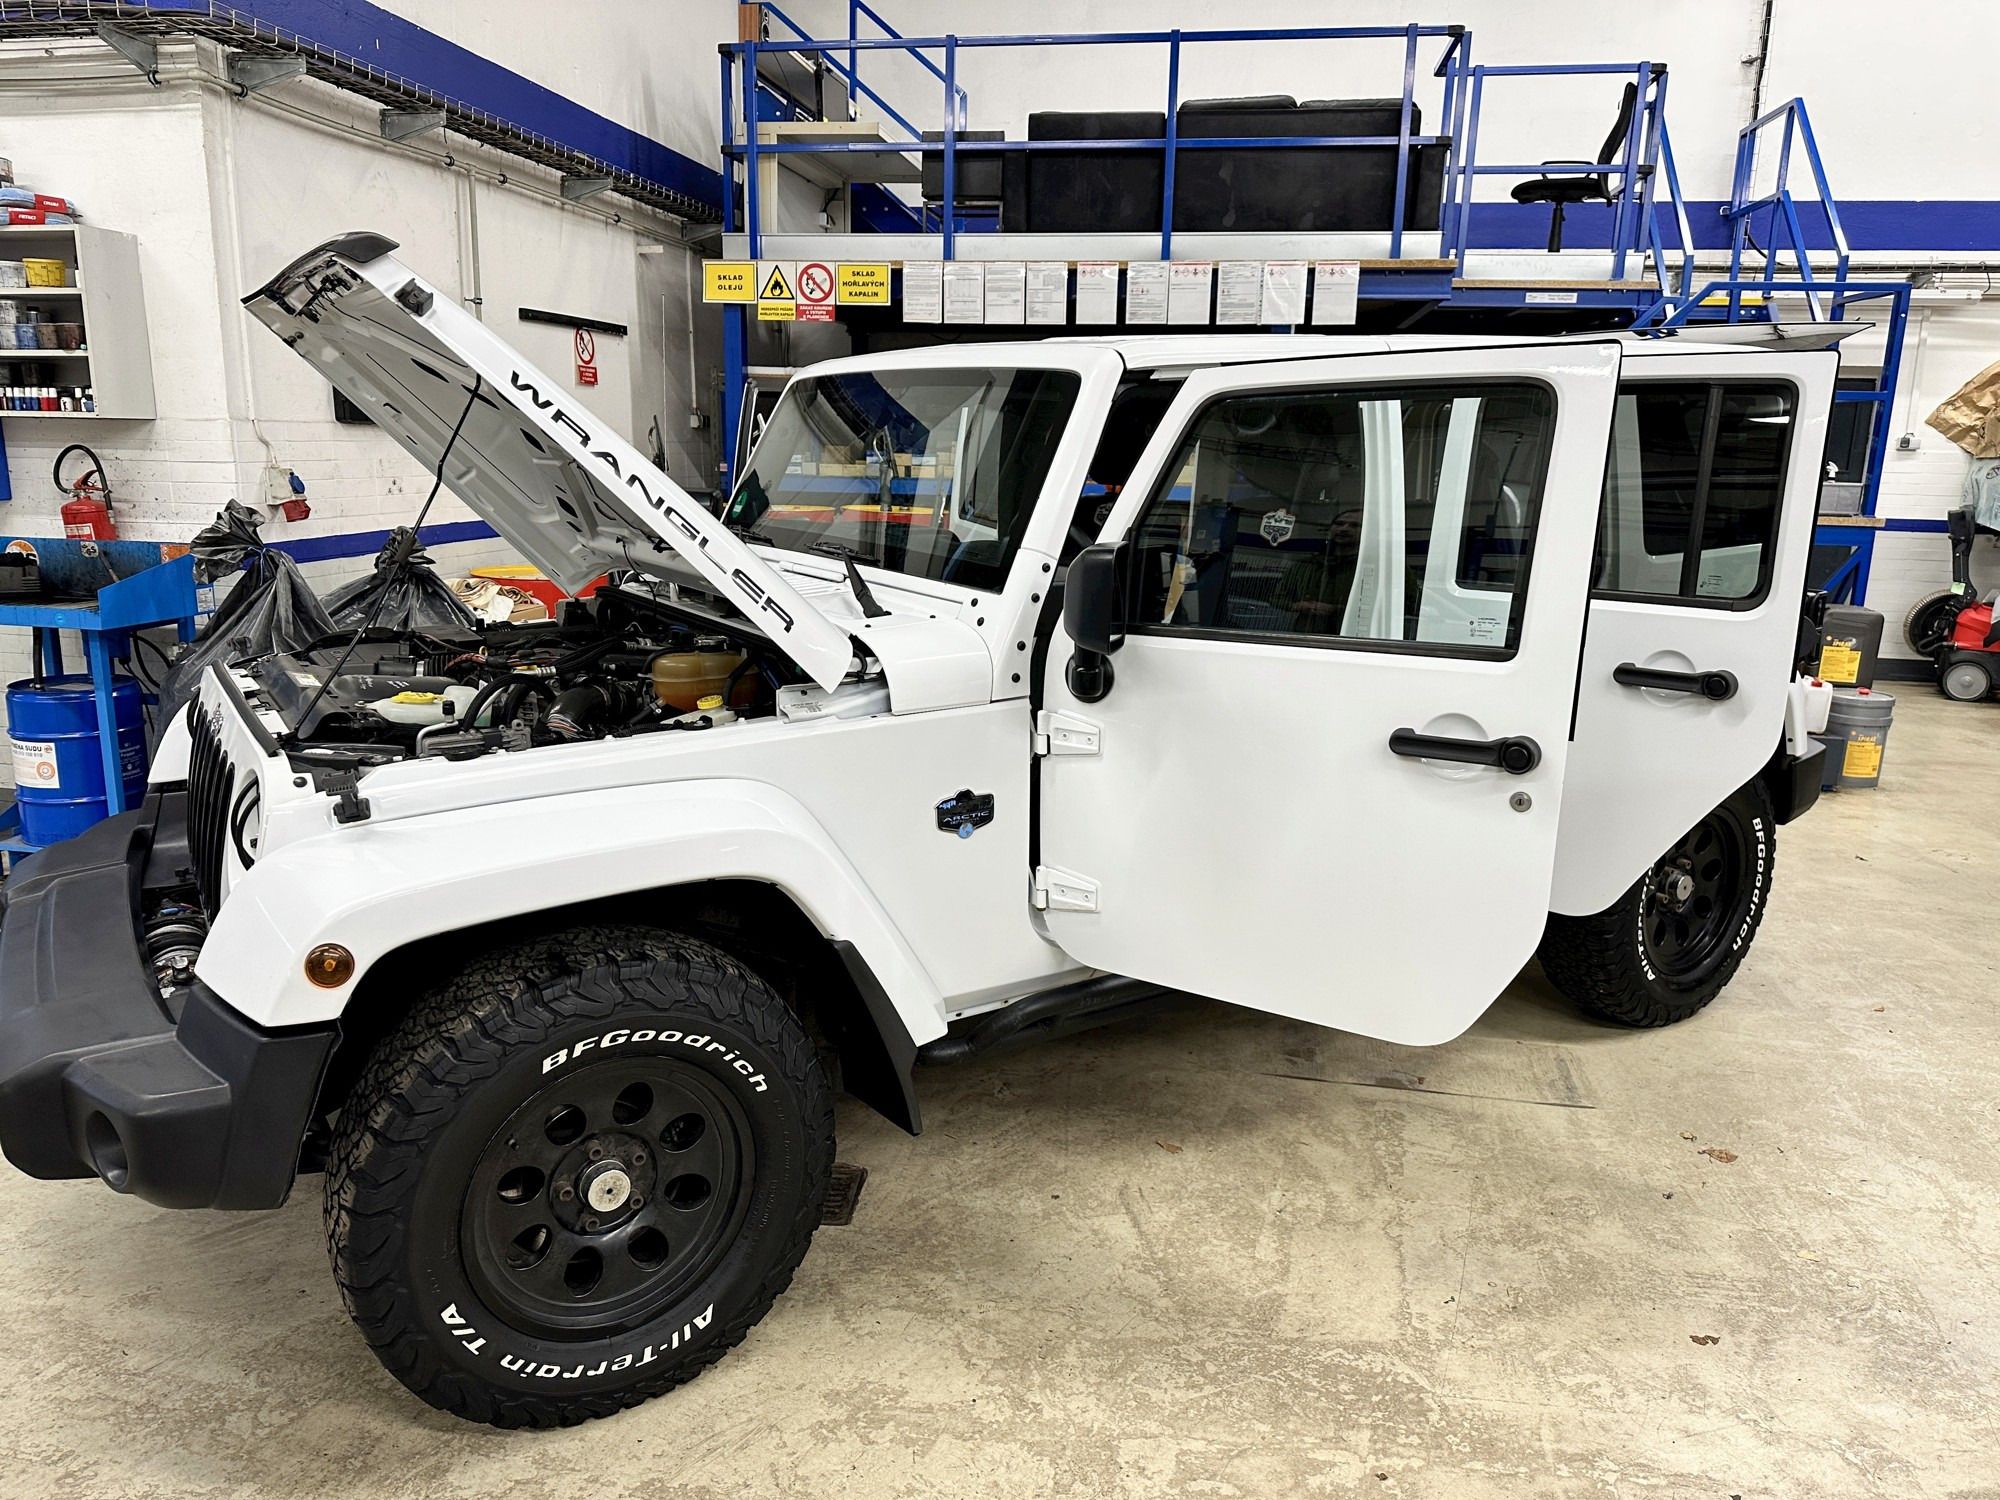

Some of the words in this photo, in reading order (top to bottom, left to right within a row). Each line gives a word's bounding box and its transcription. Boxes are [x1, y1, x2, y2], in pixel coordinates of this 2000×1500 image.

[510, 370, 795, 634] WRANGLER
[943, 810, 989, 823] ARCTIC
[1732, 817, 1766, 951] BFGoodrich
[542, 1029, 768, 1093] BFGoodrich
[440, 1303, 487, 1356] T/A
[499, 1303, 714, 1379] All-Terrain
